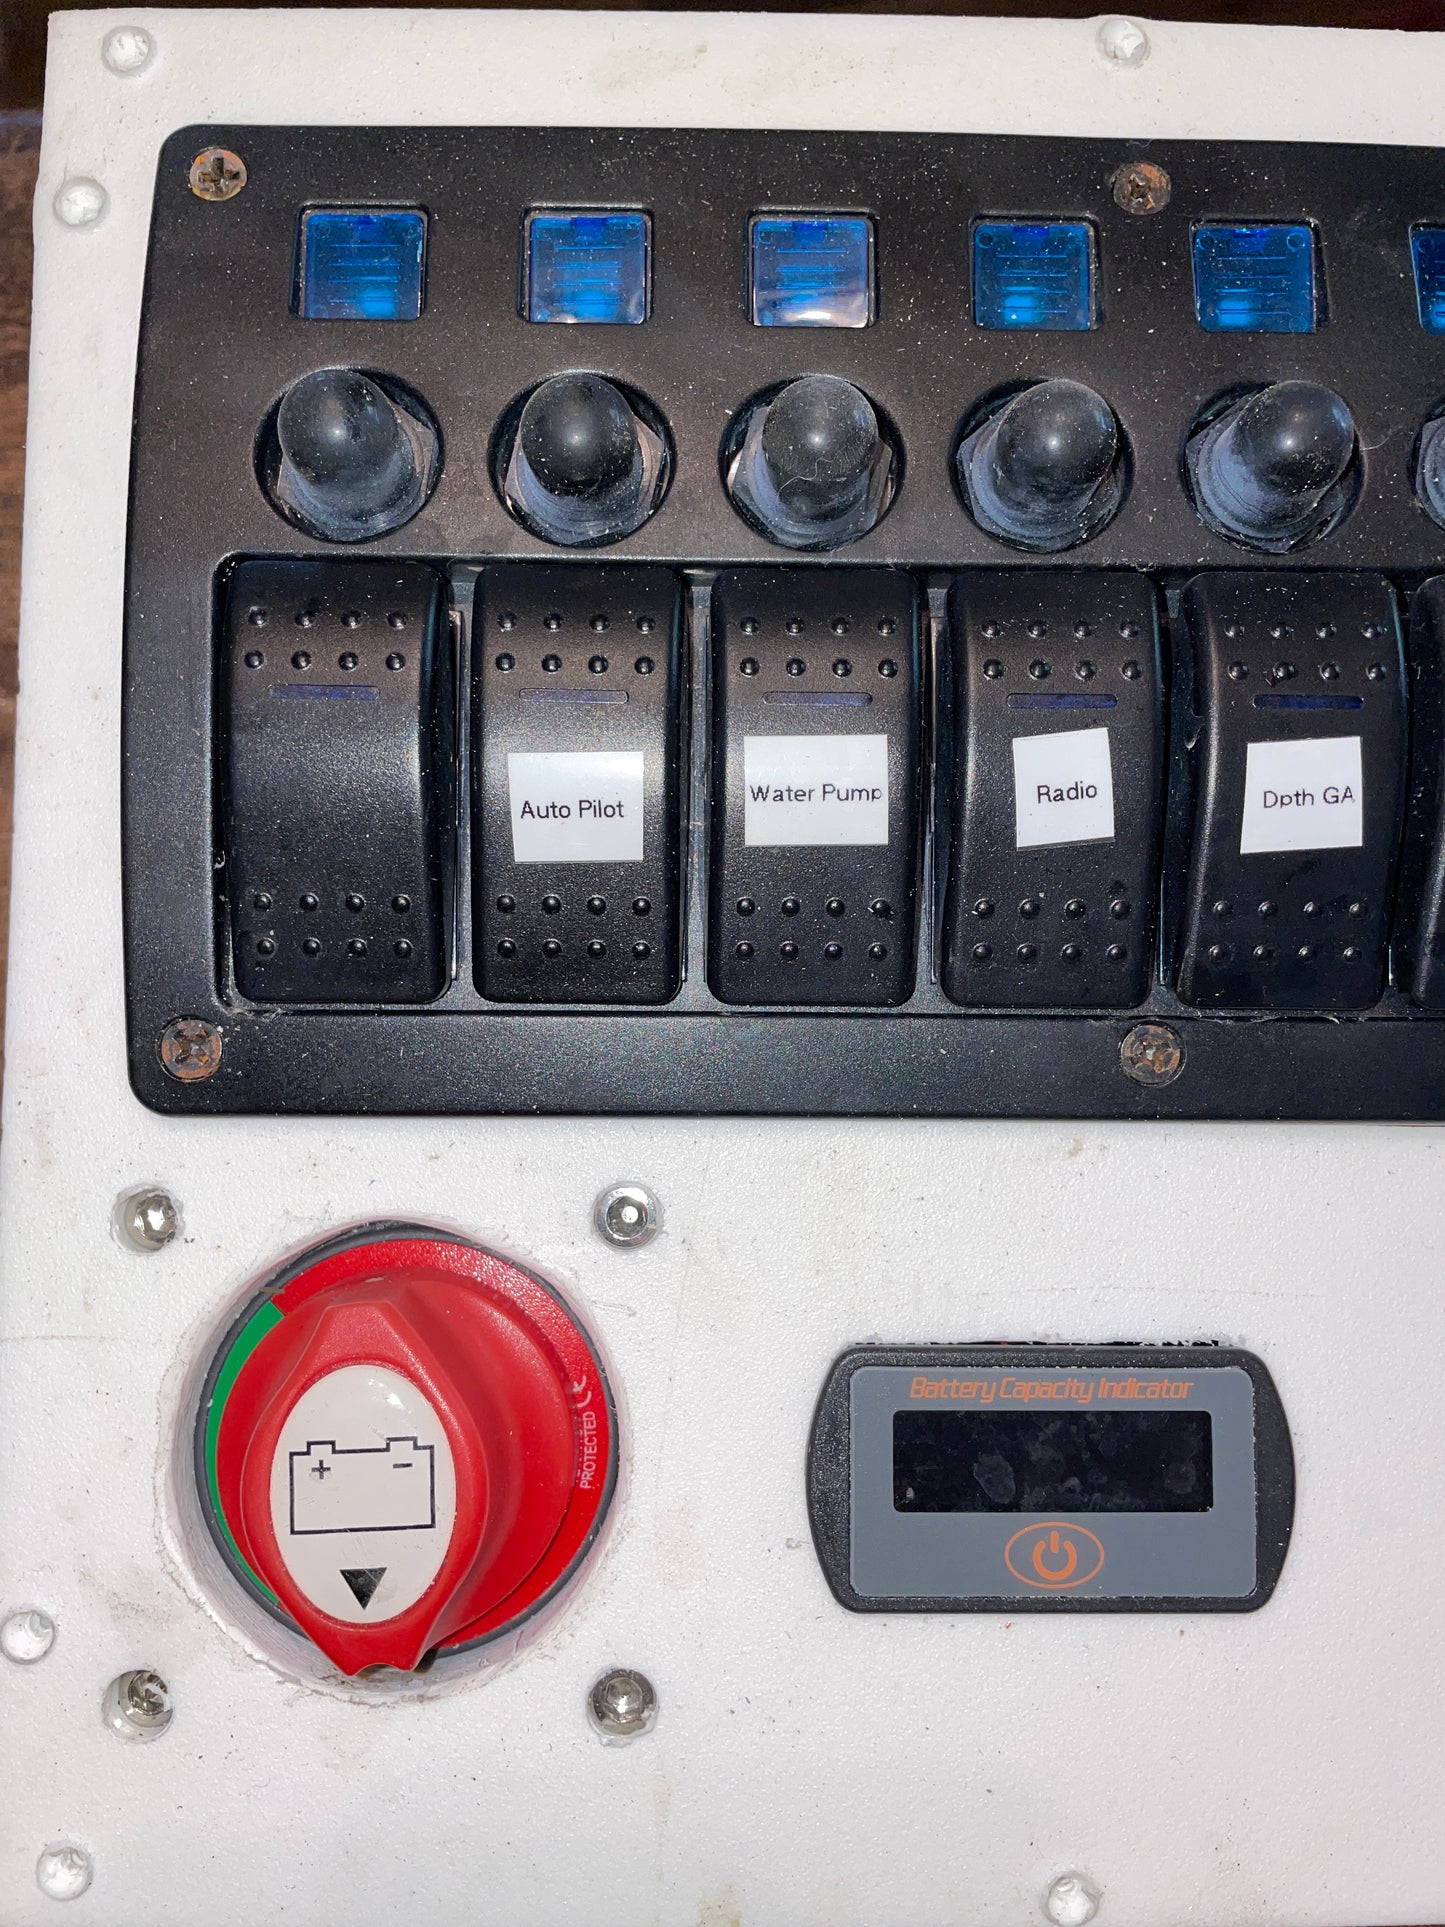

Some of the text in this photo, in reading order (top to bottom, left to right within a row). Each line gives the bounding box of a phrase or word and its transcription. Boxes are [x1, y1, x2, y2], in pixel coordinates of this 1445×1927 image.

[749, 783, 883, 803] Water Pump
[1036, 780, 1098, 805] Radio
[1262, 785, 1357, 809] Dpth GA
[520, 799, 625, 820] Auto Pilot
[909, 1376, 1195, 1404] Battery Capacity Indicator
[579, 1411, 598, 1489] PROTECTED
